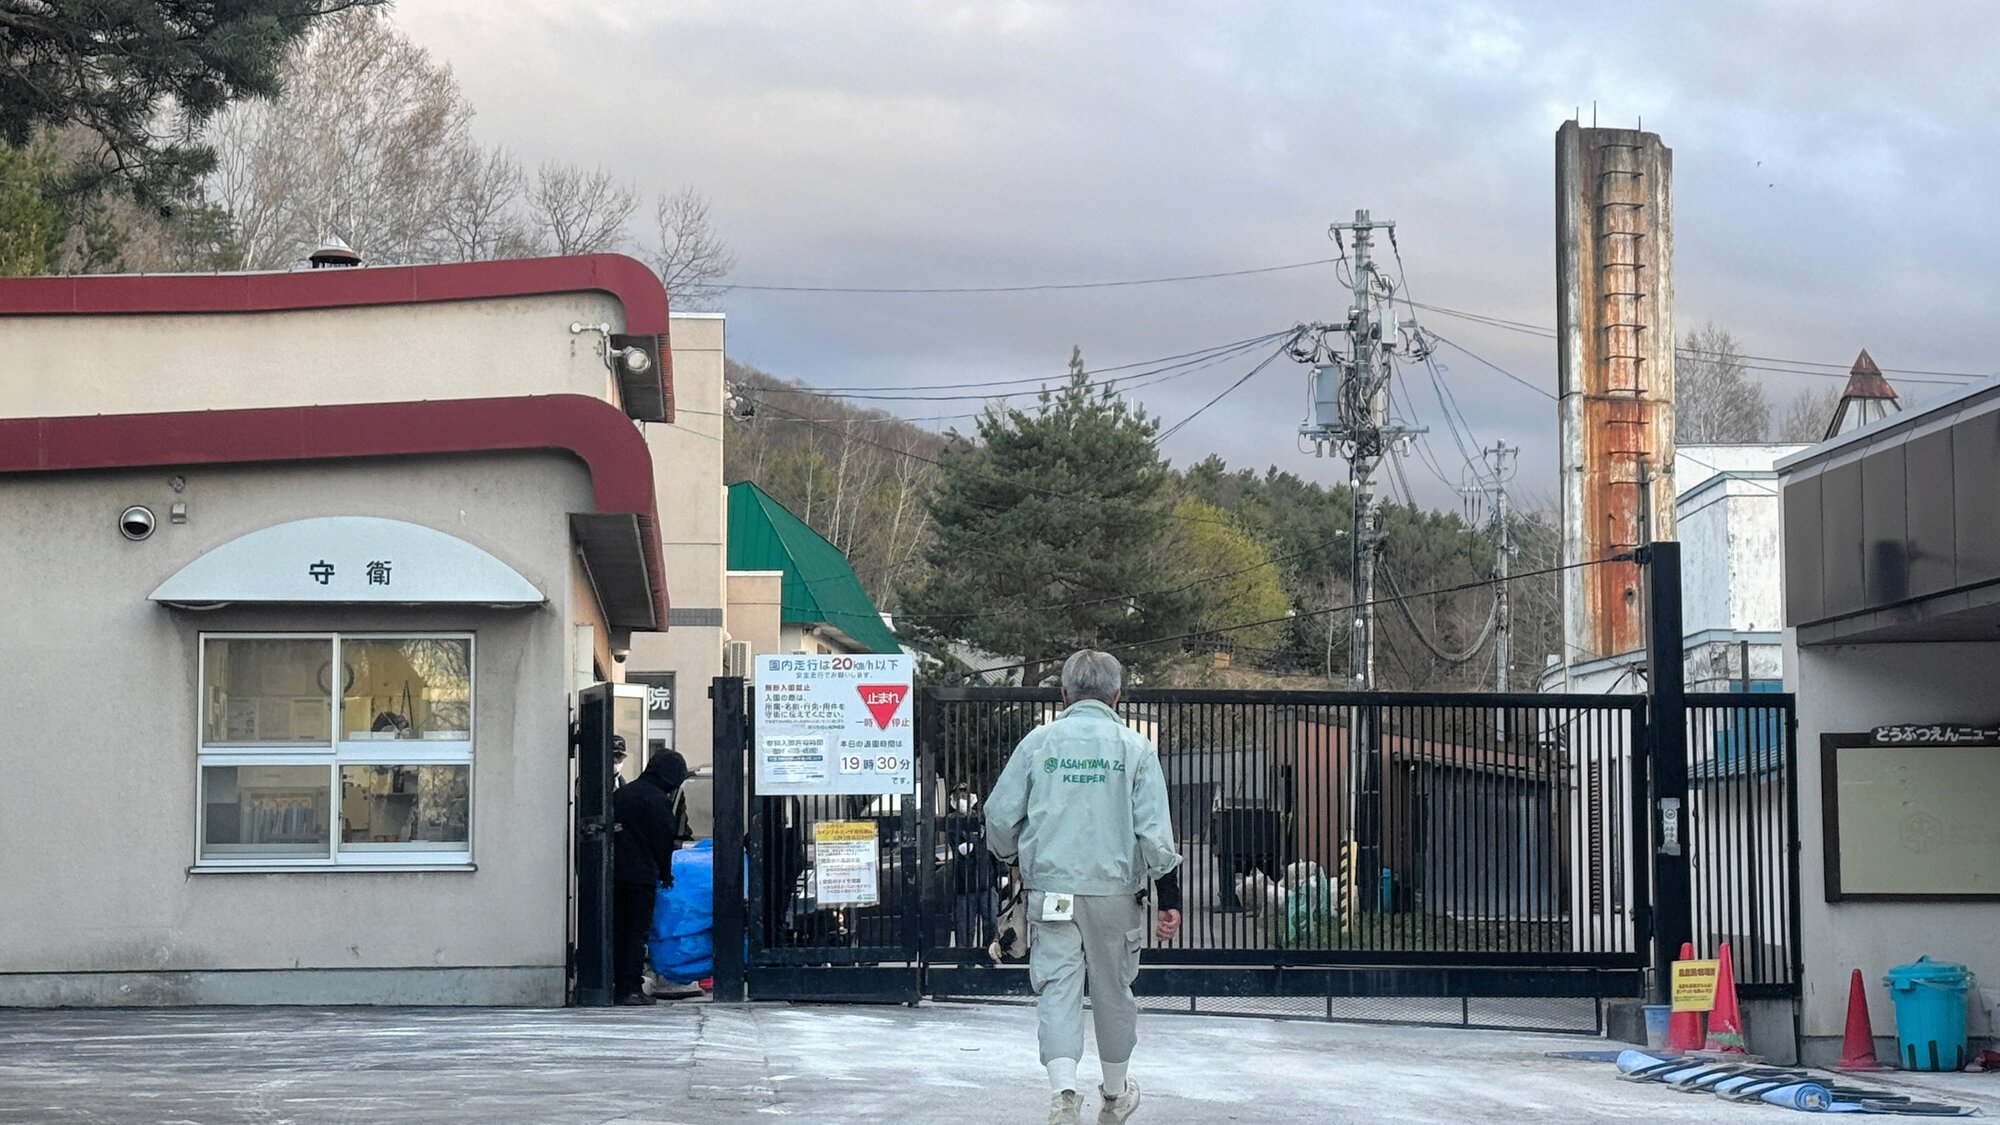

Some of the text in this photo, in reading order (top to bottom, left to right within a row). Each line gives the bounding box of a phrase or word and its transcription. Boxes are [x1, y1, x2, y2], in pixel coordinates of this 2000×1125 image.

[309, 560, 392, 585] 守衛
[867, 691, 899, 705] 止まれ
[856, 719, 873, 728] 一時
[891, 718, 910, 728] 停止
[1876, 726, 2000, 742] どうぶつえんニュー
[1060, 759, 1110, 770] ASAHIYAMA
[1063, 775, 1105, 783] KEEPER
